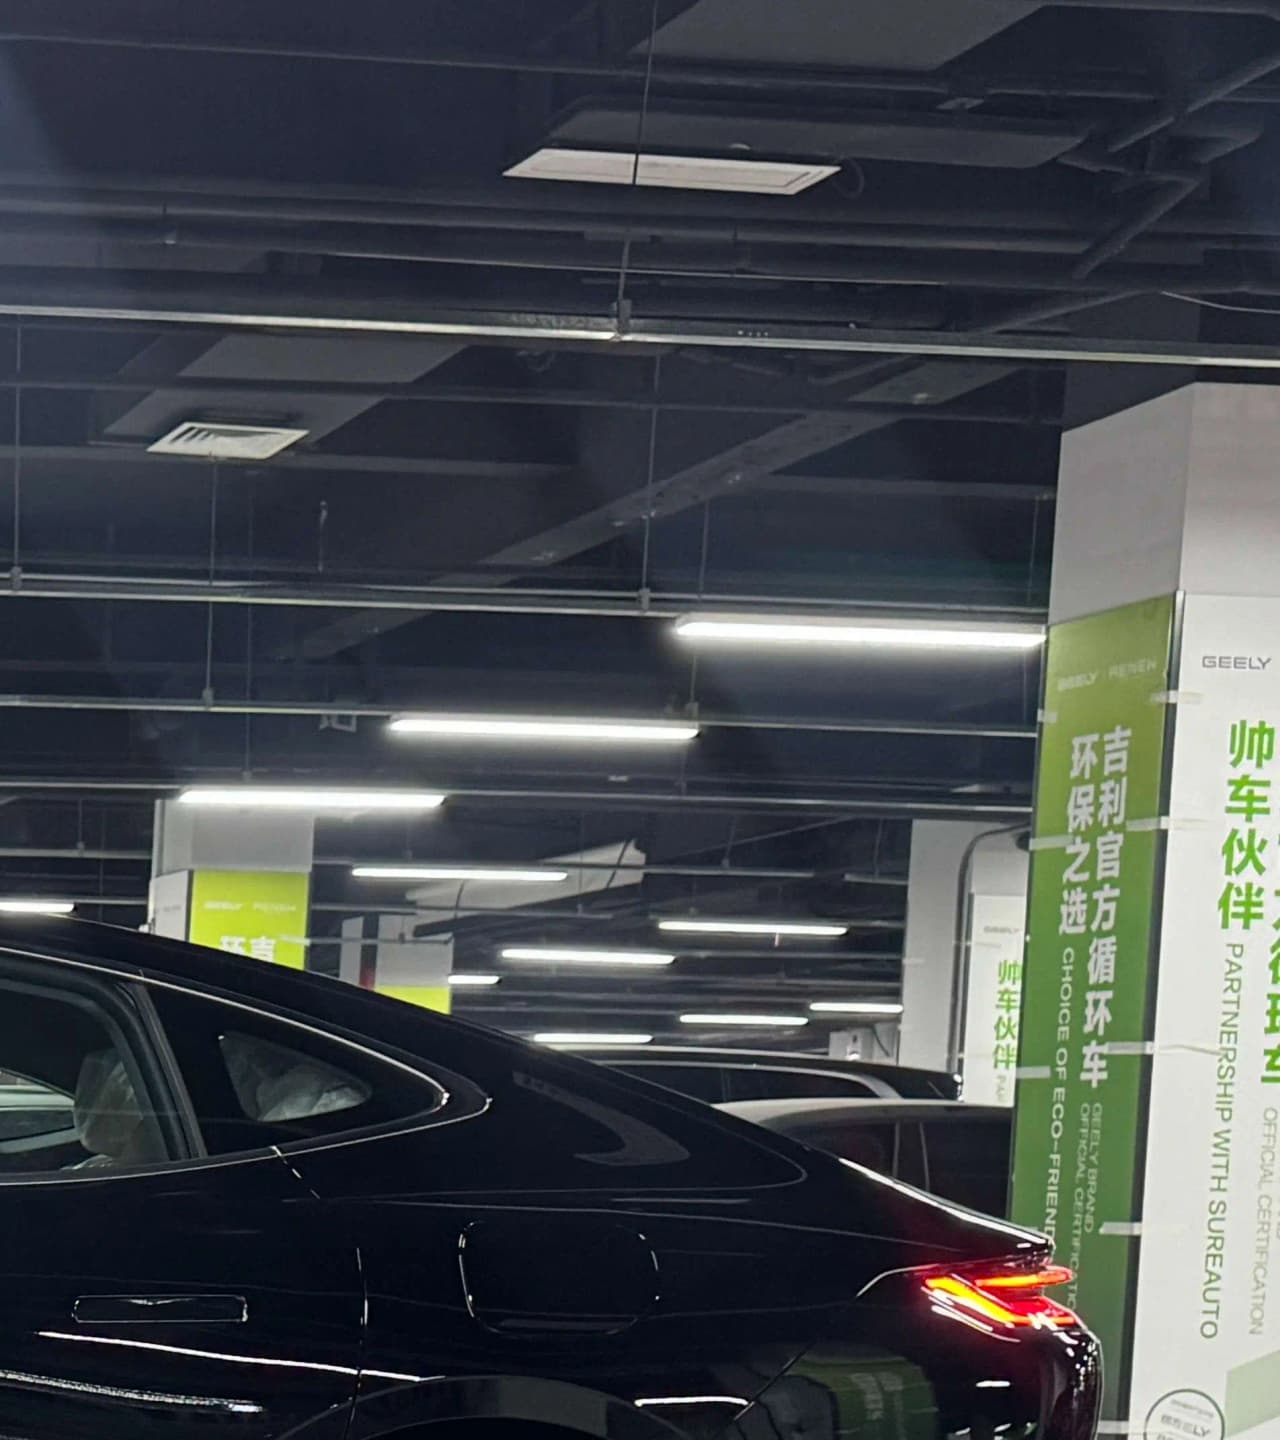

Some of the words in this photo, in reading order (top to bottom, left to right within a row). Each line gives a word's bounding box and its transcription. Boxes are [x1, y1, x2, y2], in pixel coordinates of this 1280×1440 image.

[1202, 655, 1272, 670] GEELY
[1059, 732, 1100, 936] 环保之选
[1218, 719, 1275, 931] 帅车伙伴
[1080, 724, 1132, 1089] 吉利官方循环车
[993, 959, 1022, 1070] 帅车伙伴
[1057, 947, 1075, 1042] CHOICE
[1215, 943, 1244, 1122] PARTNERSHIP
[1055, 1047, 1068, 1081] OF
[1075, 1103, 1090, 1184] OFFICIAL
[1089, 1103, 1103, 1166] GEELY
[1209, 1129, 1232, 1192] WITH
[1258, 1107, 1278, 1190] OFFICIAL
[1084, 1167, 1098, 1233] BRAND
[1200, 1200, 1226, 1339] SUREAUTO
[1249, 1194, 1272, 1336] CERTIFICATION
